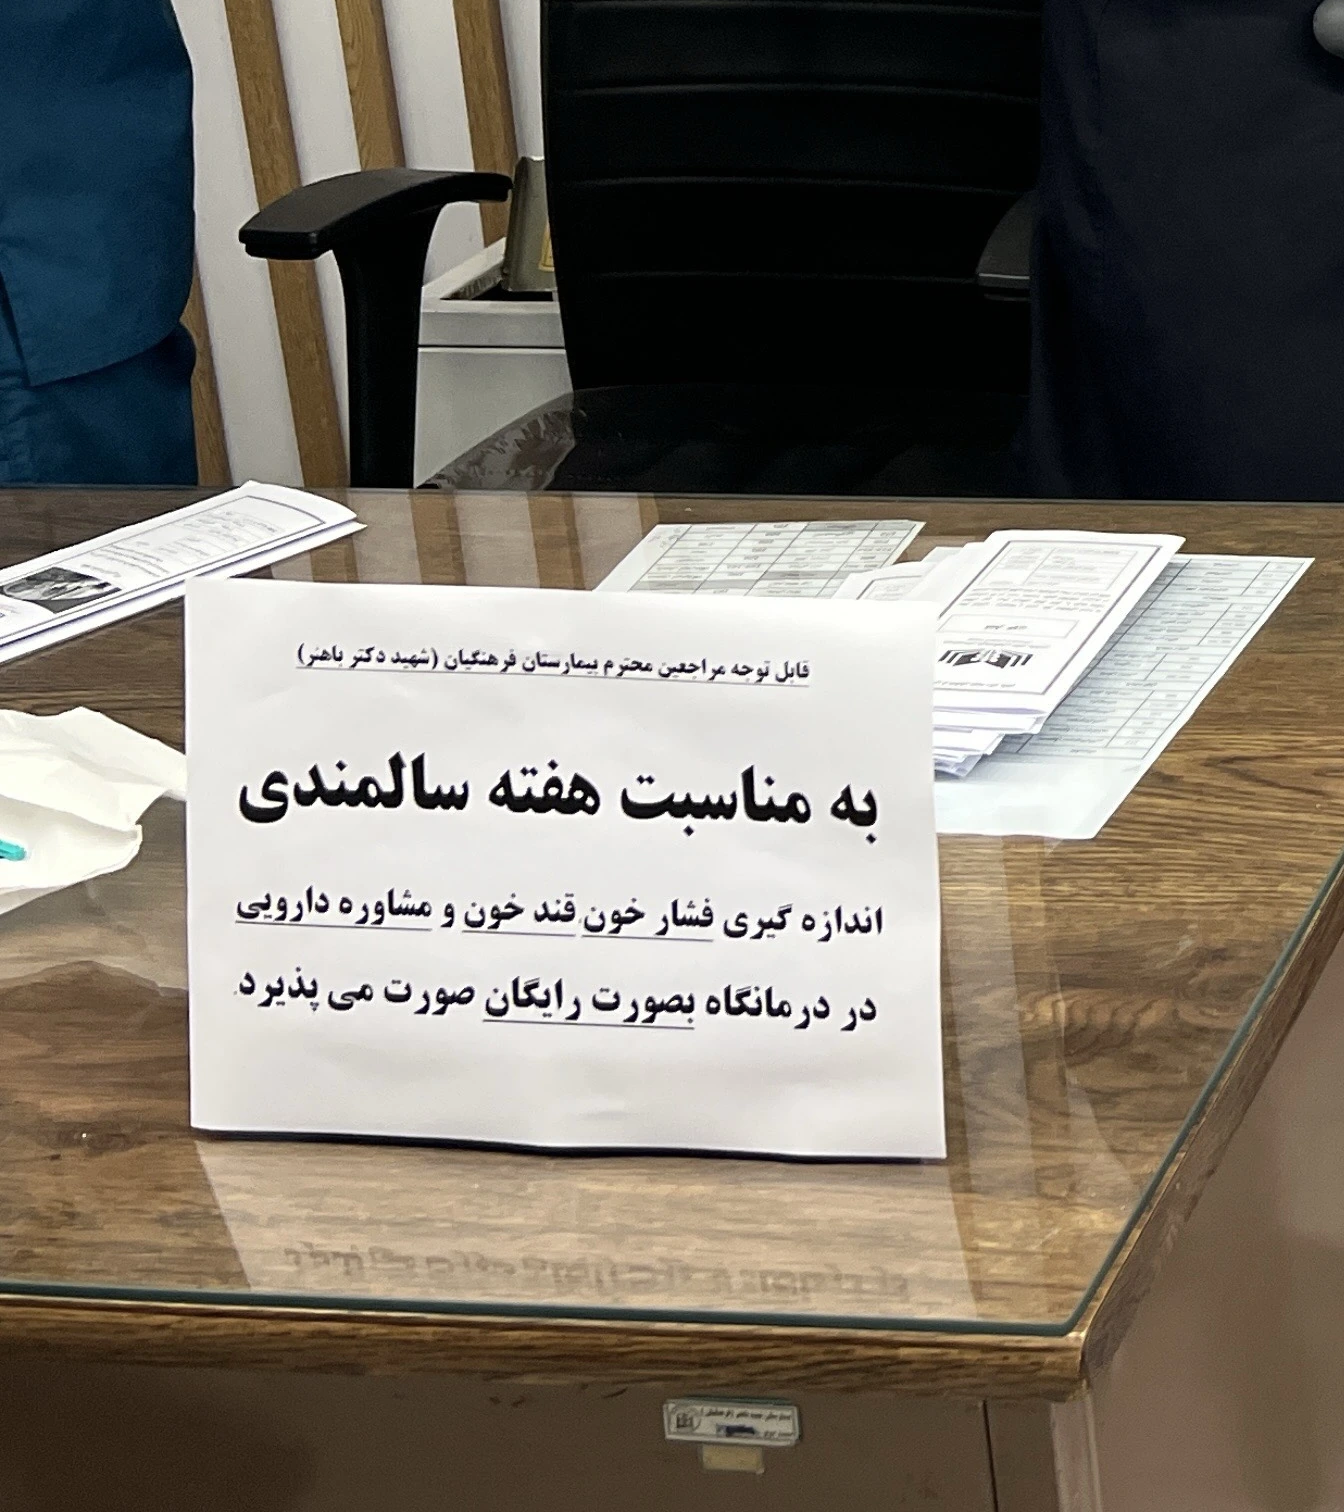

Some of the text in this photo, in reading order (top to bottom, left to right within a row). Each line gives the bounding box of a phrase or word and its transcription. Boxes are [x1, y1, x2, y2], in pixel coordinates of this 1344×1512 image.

[350, 646, 386, 669] دکتر
[444, 648, 518, 673] فرهنگیان
[522, 650, 599, 675] بیمارستان
[603, 657, 653, 676] محترم
[658, 658, 726, 681] مراجعین
[731, 660, 770, 683] توجه
[775, 660, 810, 684] قابل
[239, 751, 878, 844] به مناسبت هفته سالمندی
[236, 885, 331, 922] دارویی
[339, 888, 433, 926] مشاوره
[440, 902, 456, 928] و
[463, 892, 524, 930] خون
[533, 892, 576, 924] قند
[655, 897, 714, 936] فشار
[723, 902, 794, 940] گیری
[801, 905, 884, 942] اندازه
[327, 984, 375, 1011] می
[384, 979, 476, 1016] صورت
[485, 975, 582, 1021] رایگان
[591, 987, 696, 1024] بصورت
[705, 983, 831, 1030] درمانگاه
[840, 996, 878, 1032] در
